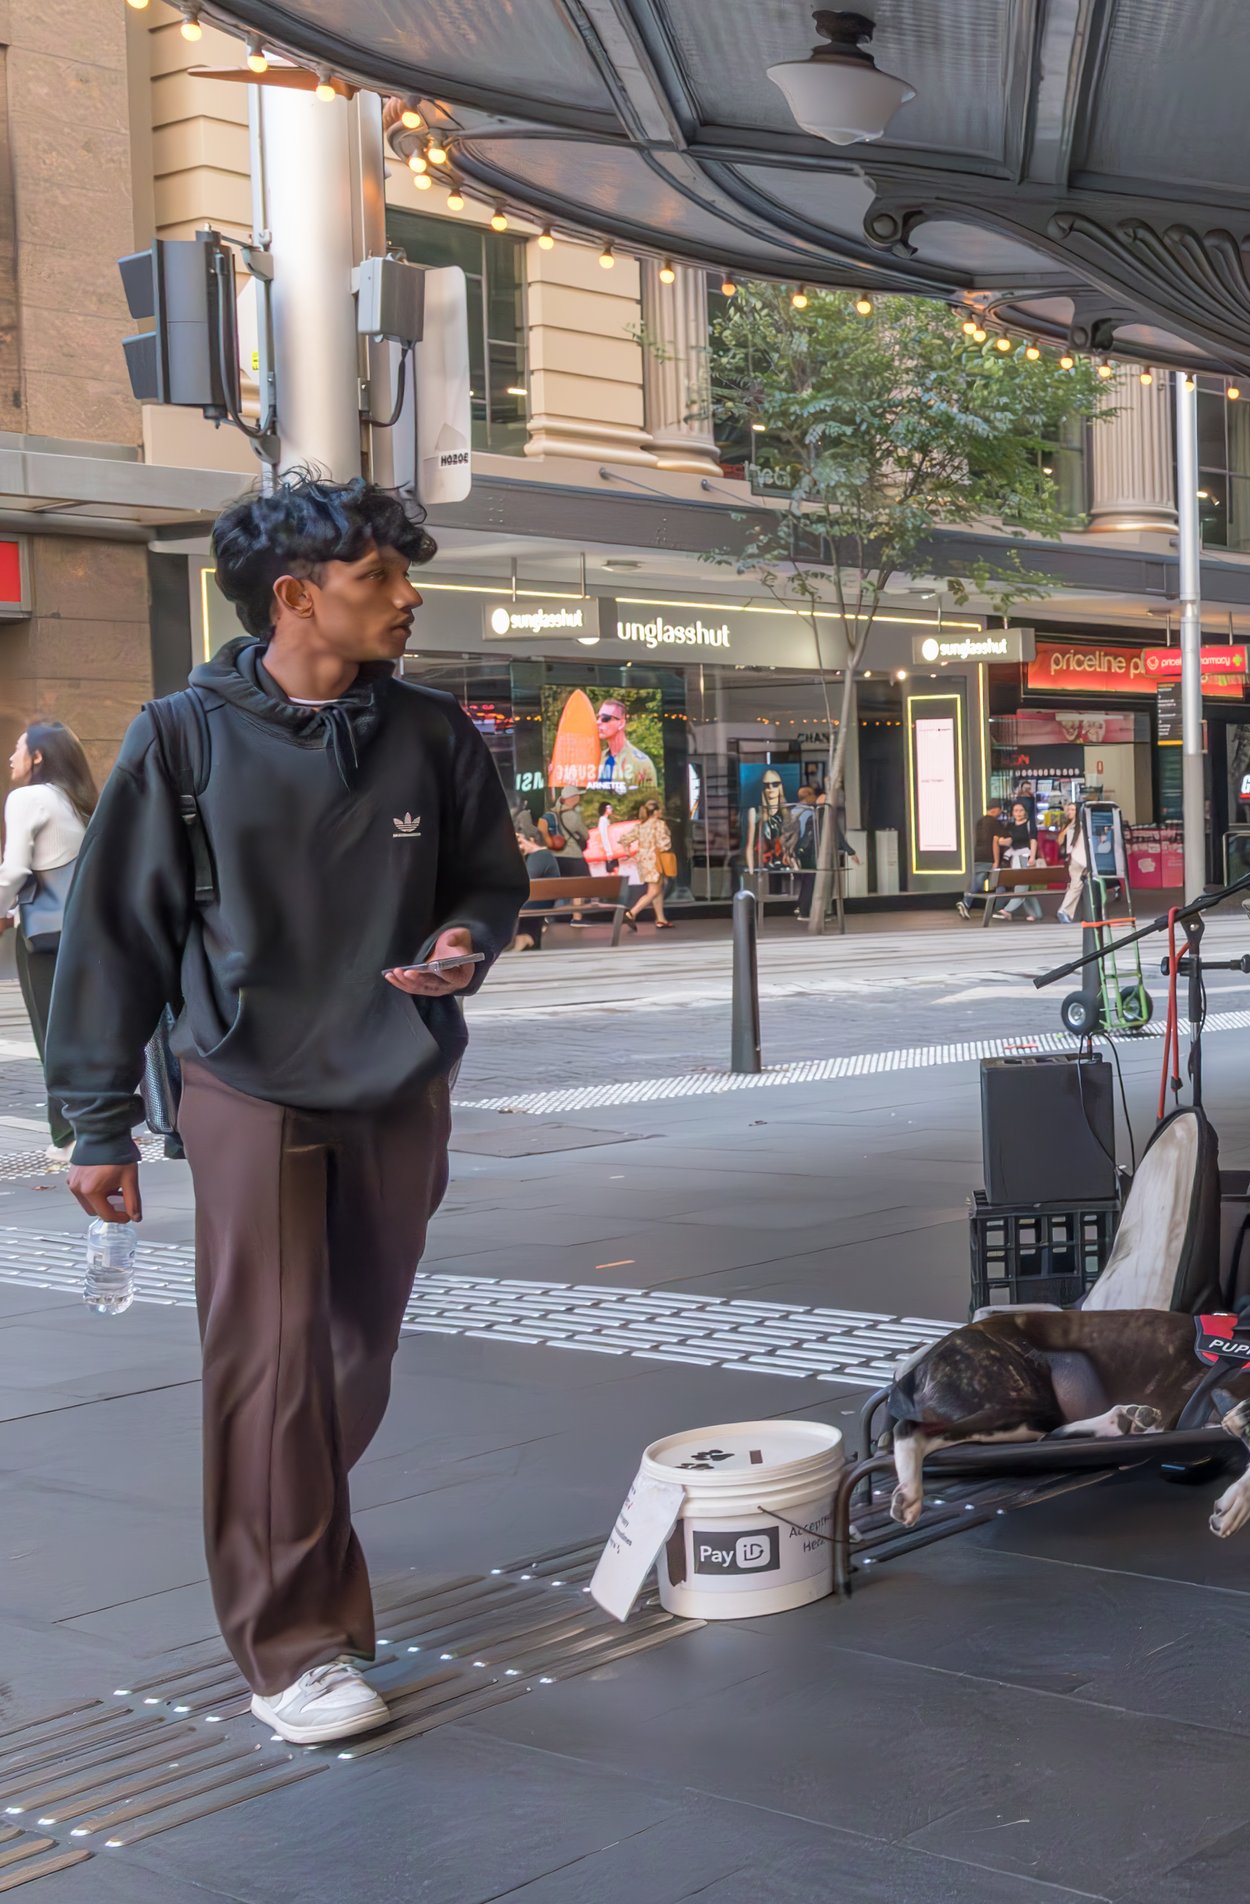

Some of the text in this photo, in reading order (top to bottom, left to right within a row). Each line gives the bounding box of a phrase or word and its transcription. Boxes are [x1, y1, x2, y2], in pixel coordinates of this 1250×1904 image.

[510, 608, 583, 633] sunglasshut
[616, 617, 730, 649] unglasshut
[940, 637, 1008, 659] sunglasshut
[1050, 650, 1126, 676] priceline
[700, 1545, 734, 1567] Pay
